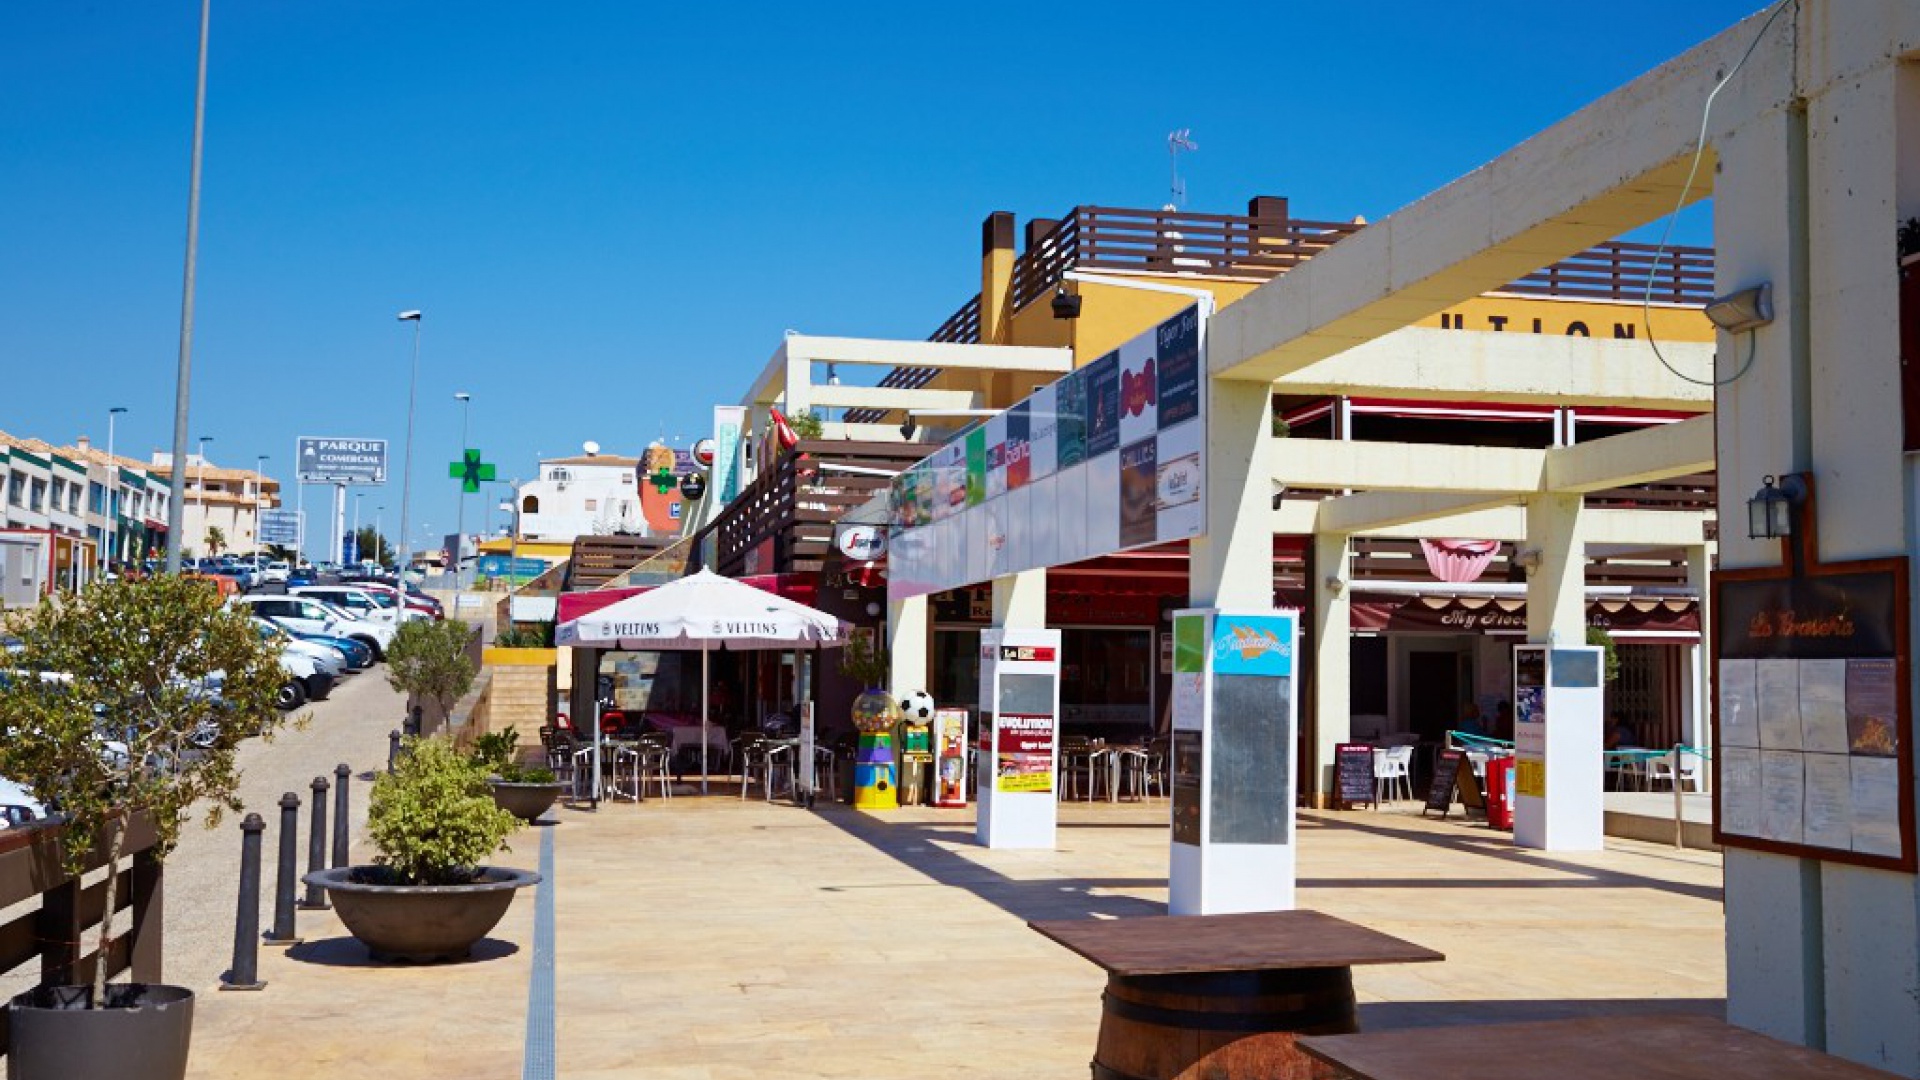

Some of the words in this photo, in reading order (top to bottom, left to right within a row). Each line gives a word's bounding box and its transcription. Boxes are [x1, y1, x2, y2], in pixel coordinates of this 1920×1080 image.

[319, 441, 381, 453] PARQUE
[320, 454, 380, 463] COMERCIAL
[614, 622, 660, 636] VELTINS
[726, 621, 778, 635] VELTINS
